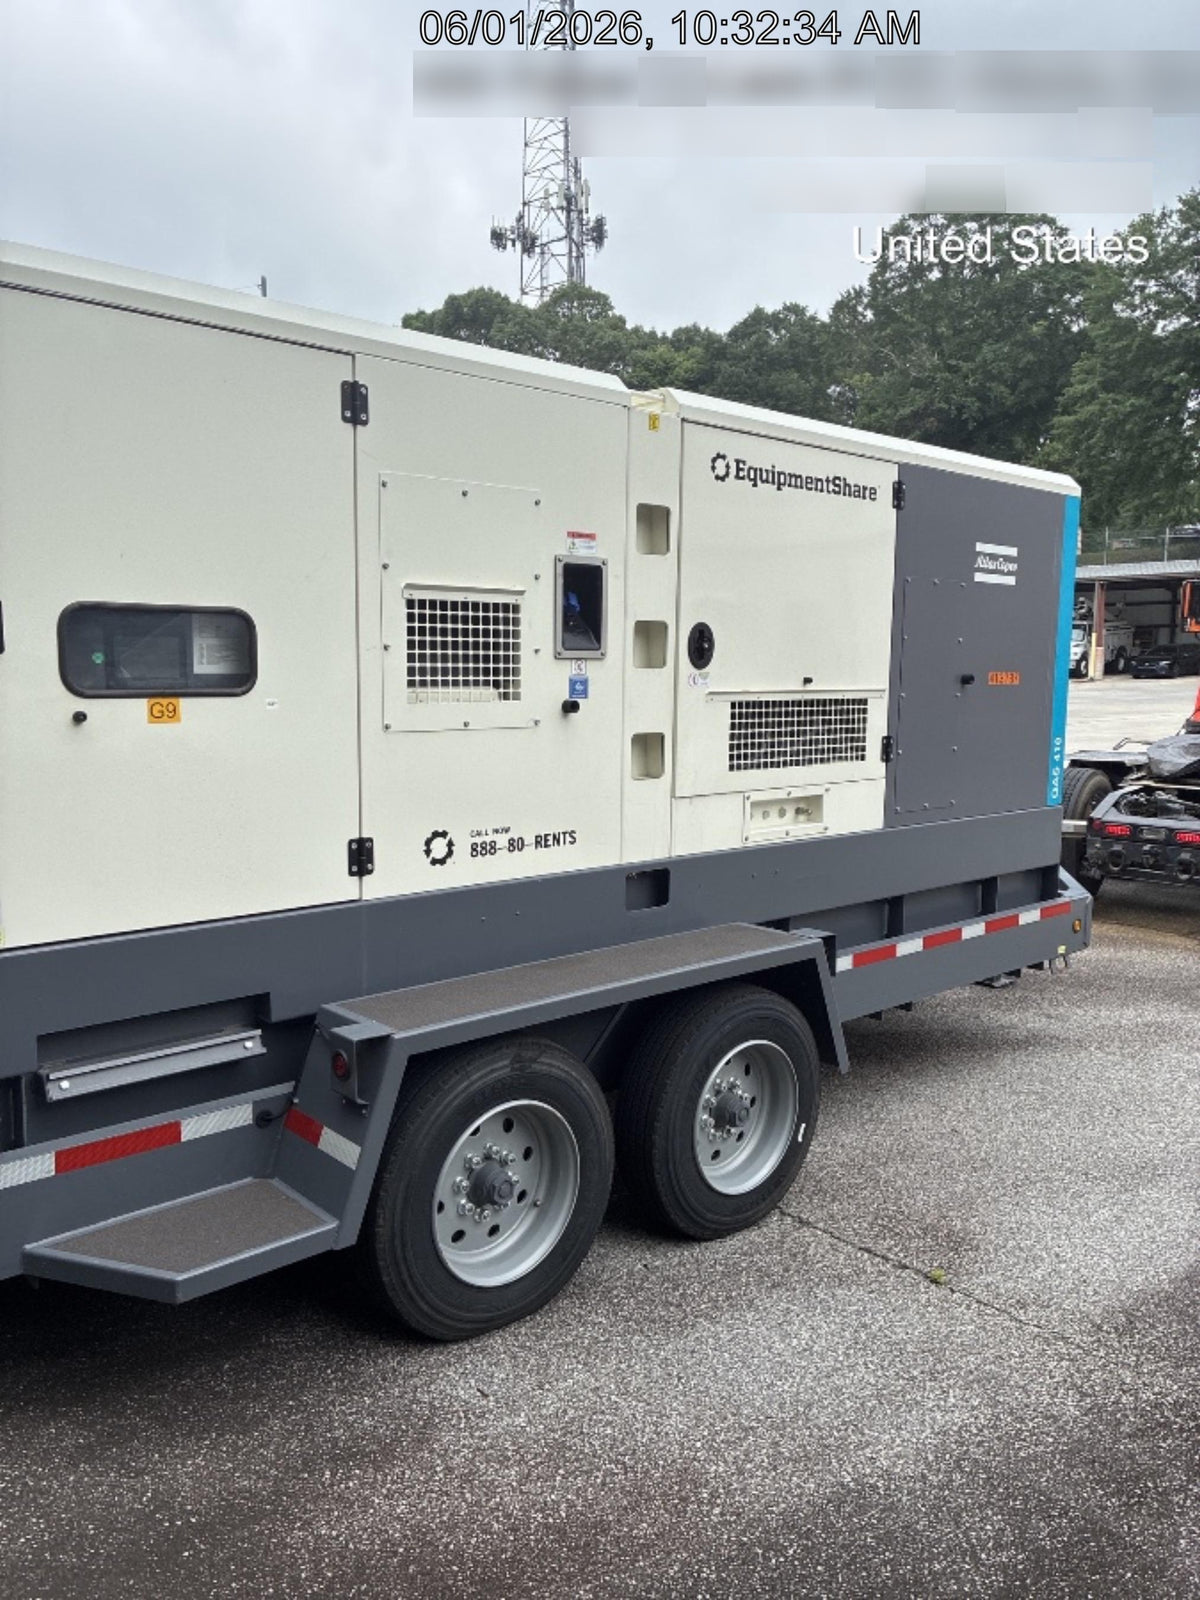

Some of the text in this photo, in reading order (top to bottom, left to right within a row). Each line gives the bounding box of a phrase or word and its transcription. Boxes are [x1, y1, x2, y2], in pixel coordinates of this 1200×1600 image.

[733, 458, 878, 502] EquipmentShare
[150, 702, 177, 719] G9
[1053, 736, 1063, 761] 410
[470, 826, 511, 838] CALL NOW
[470, 829, 577, 858] 888-80-RENTS
